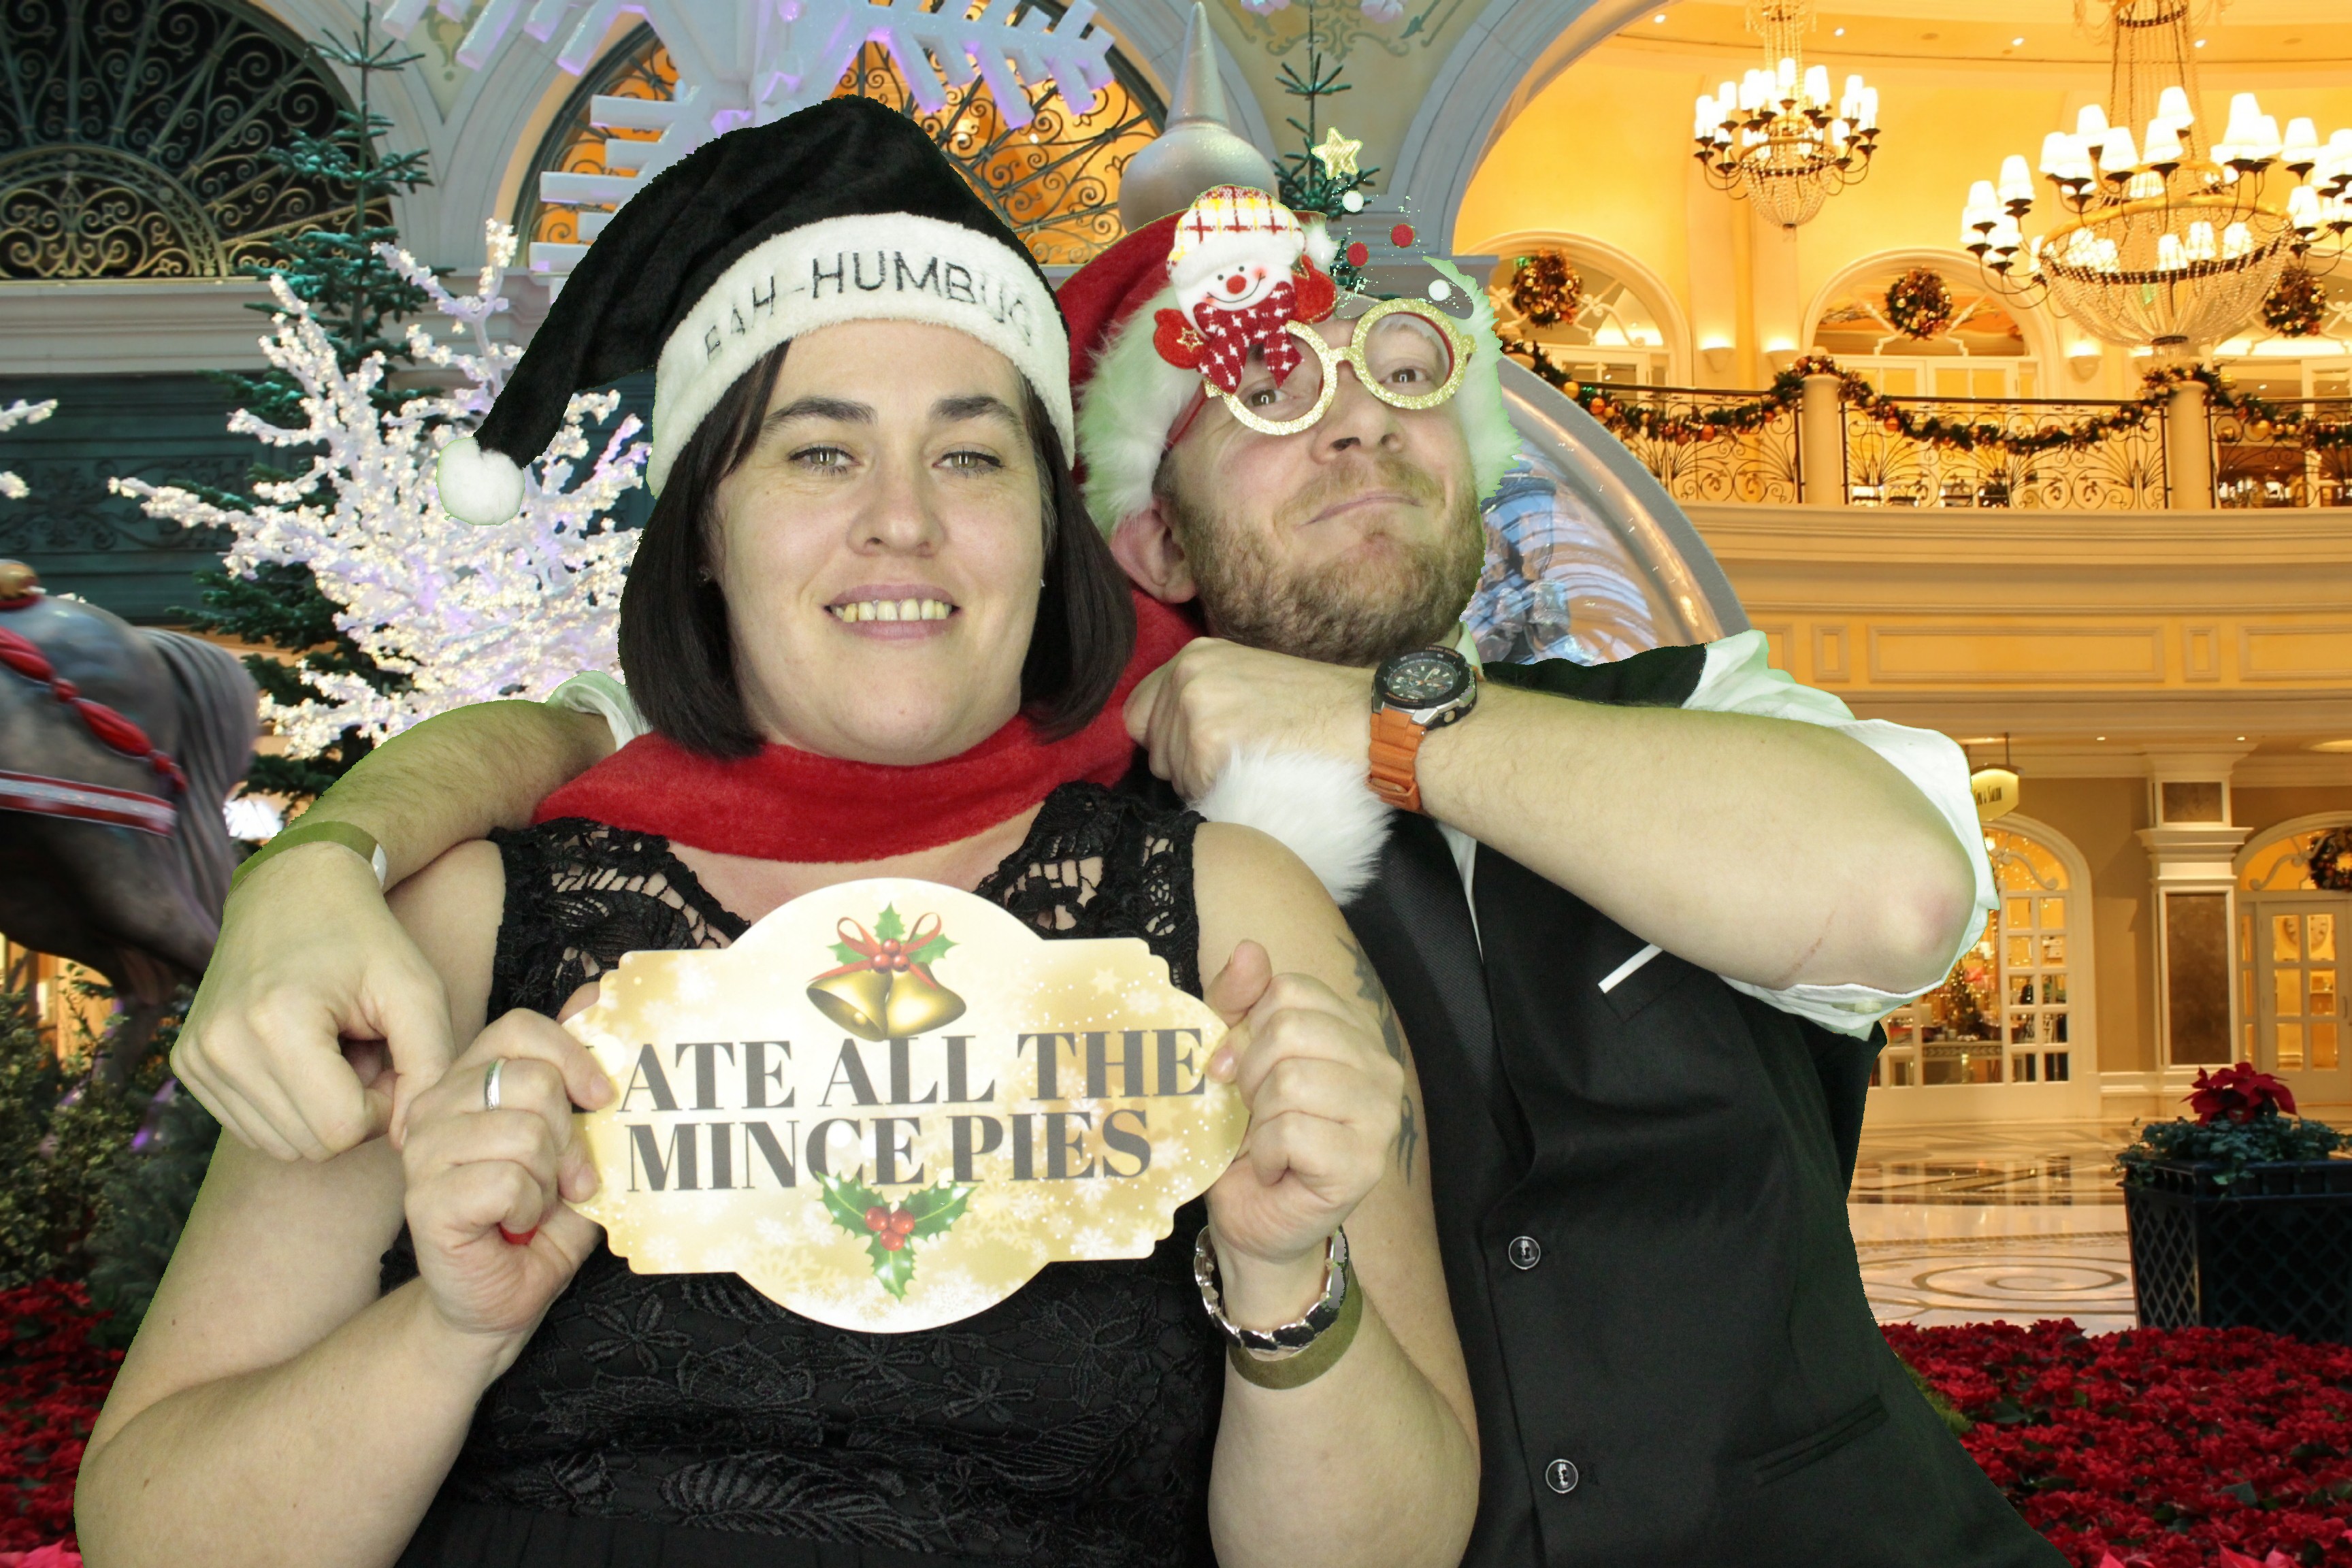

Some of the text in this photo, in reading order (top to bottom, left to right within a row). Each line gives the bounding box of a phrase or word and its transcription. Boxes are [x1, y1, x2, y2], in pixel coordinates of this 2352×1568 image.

[617, 1040, 796, 1113] ATE
[818, 1035, 996, 1107] ALL
[1017, 1028, 1207, 1100] THE
[624, 1109, 1152, 1192] MINCE PIES
